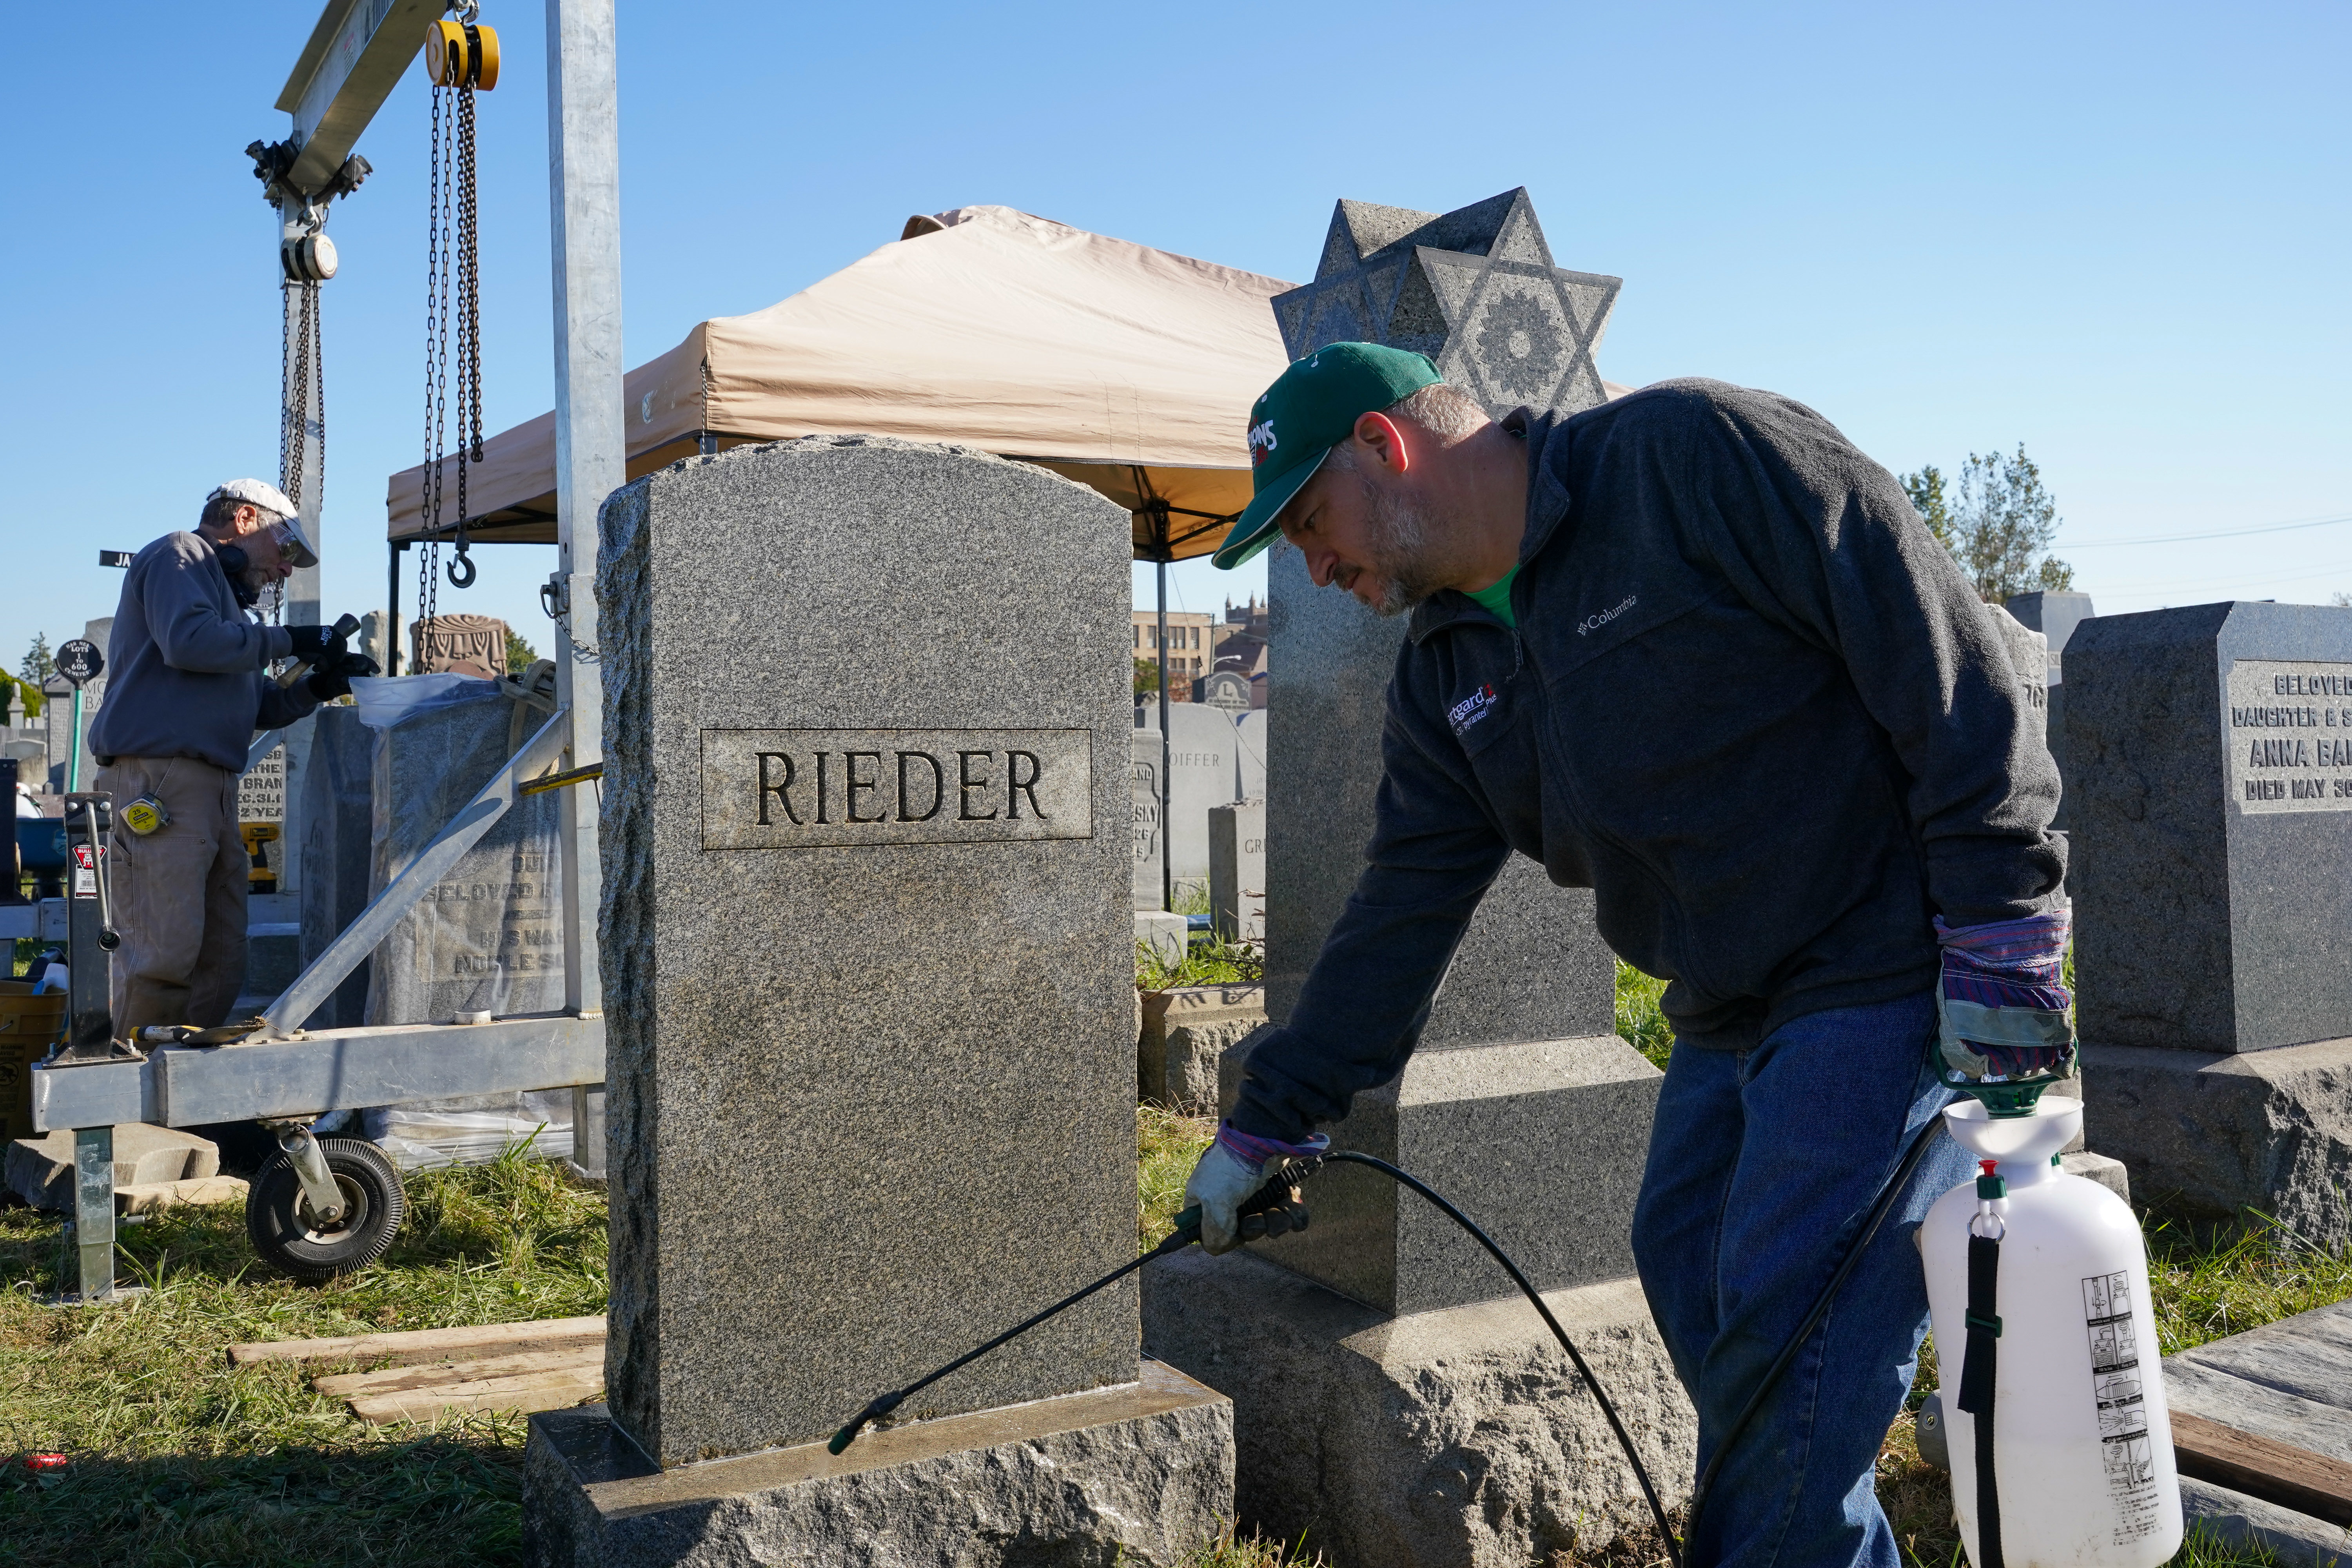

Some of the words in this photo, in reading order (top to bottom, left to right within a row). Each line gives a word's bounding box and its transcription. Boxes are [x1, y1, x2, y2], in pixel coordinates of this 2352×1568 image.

[1588, 595, 1637, 628] Columbia
[64, 667, 92, 677] CEMETERY
[1485, 694, 1497, 707] Plus
[2233, 707, 2318, 727] DAUGHTER
[2326, 707, 2337, 727] &
[2250, 739, 2310, 767] ANNA
[754, 750, 1047, 826] RIEDER
[2246, 780, 2285, 800] DIED
[2292, 778, 2327, 799] MAY
